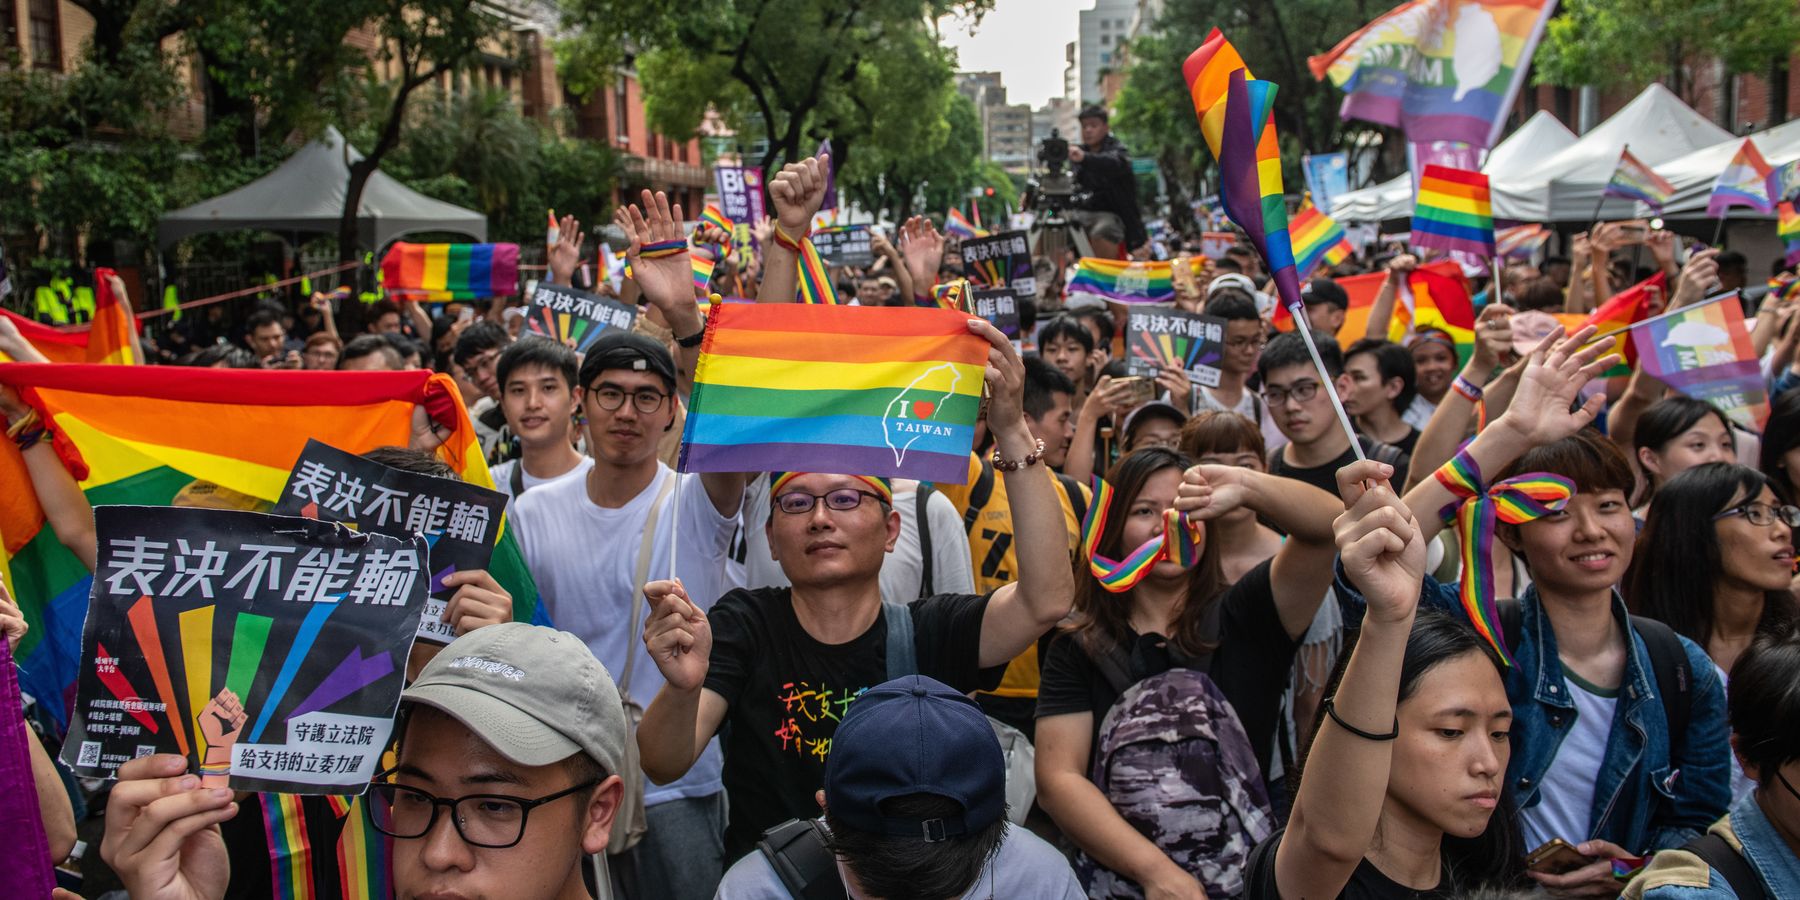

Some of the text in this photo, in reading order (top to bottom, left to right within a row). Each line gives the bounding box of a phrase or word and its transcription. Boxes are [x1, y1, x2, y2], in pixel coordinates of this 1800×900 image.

[720, 168, 745, 193] Bi
[725, 193, 748, 207] the
[963, 236, 1026, 263] 表決不能輸
[535, 288, 632, 330] 表決不能輸
[1131, 313, 1222, 343] 表決不能輸
[897, 400, 910, 418] I
[896, 422, 952, 436] TAIWAN
[291, 459, 491, 544] 表決不能輸
[104, 536, 420, 607] 表決不能輸
[448, 656, 526, 681] WHATEVER
[294, 722, 376, 746] 守護立法院
[239, 748, 362, 774] 給支持的立委力量
